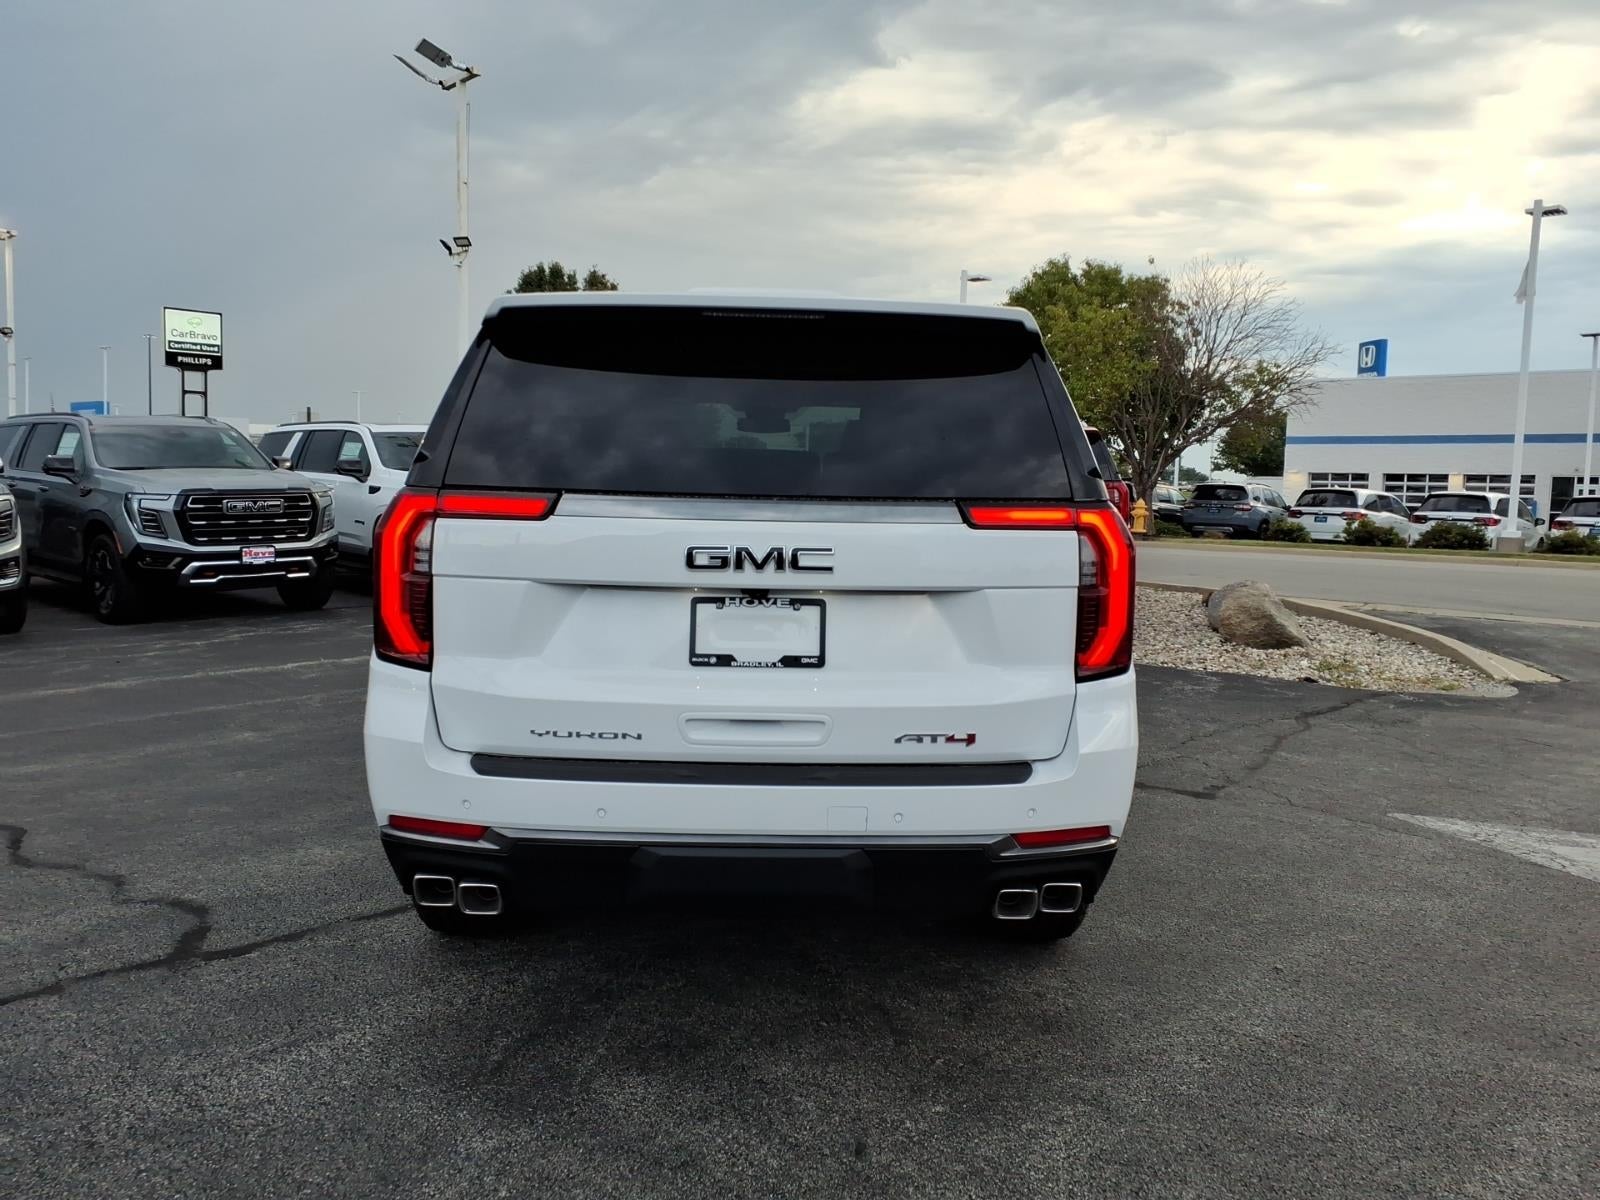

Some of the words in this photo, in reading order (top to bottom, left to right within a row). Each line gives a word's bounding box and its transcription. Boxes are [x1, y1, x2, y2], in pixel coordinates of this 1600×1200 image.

[171, 328, 218, 341] CarBravo
[170, 342, 201, 350] Certified
[201, 344, 219, 352] Used
[177, 355, 212, 365] PHILLIPS
[227, 501, 281, 513] GMC
[685, 545, 835, 573] GMC
[724, 597, 792, 609] HOVE
[529, 729, 643, 741] YUKON
[894, 733, 977, 747] AT4
